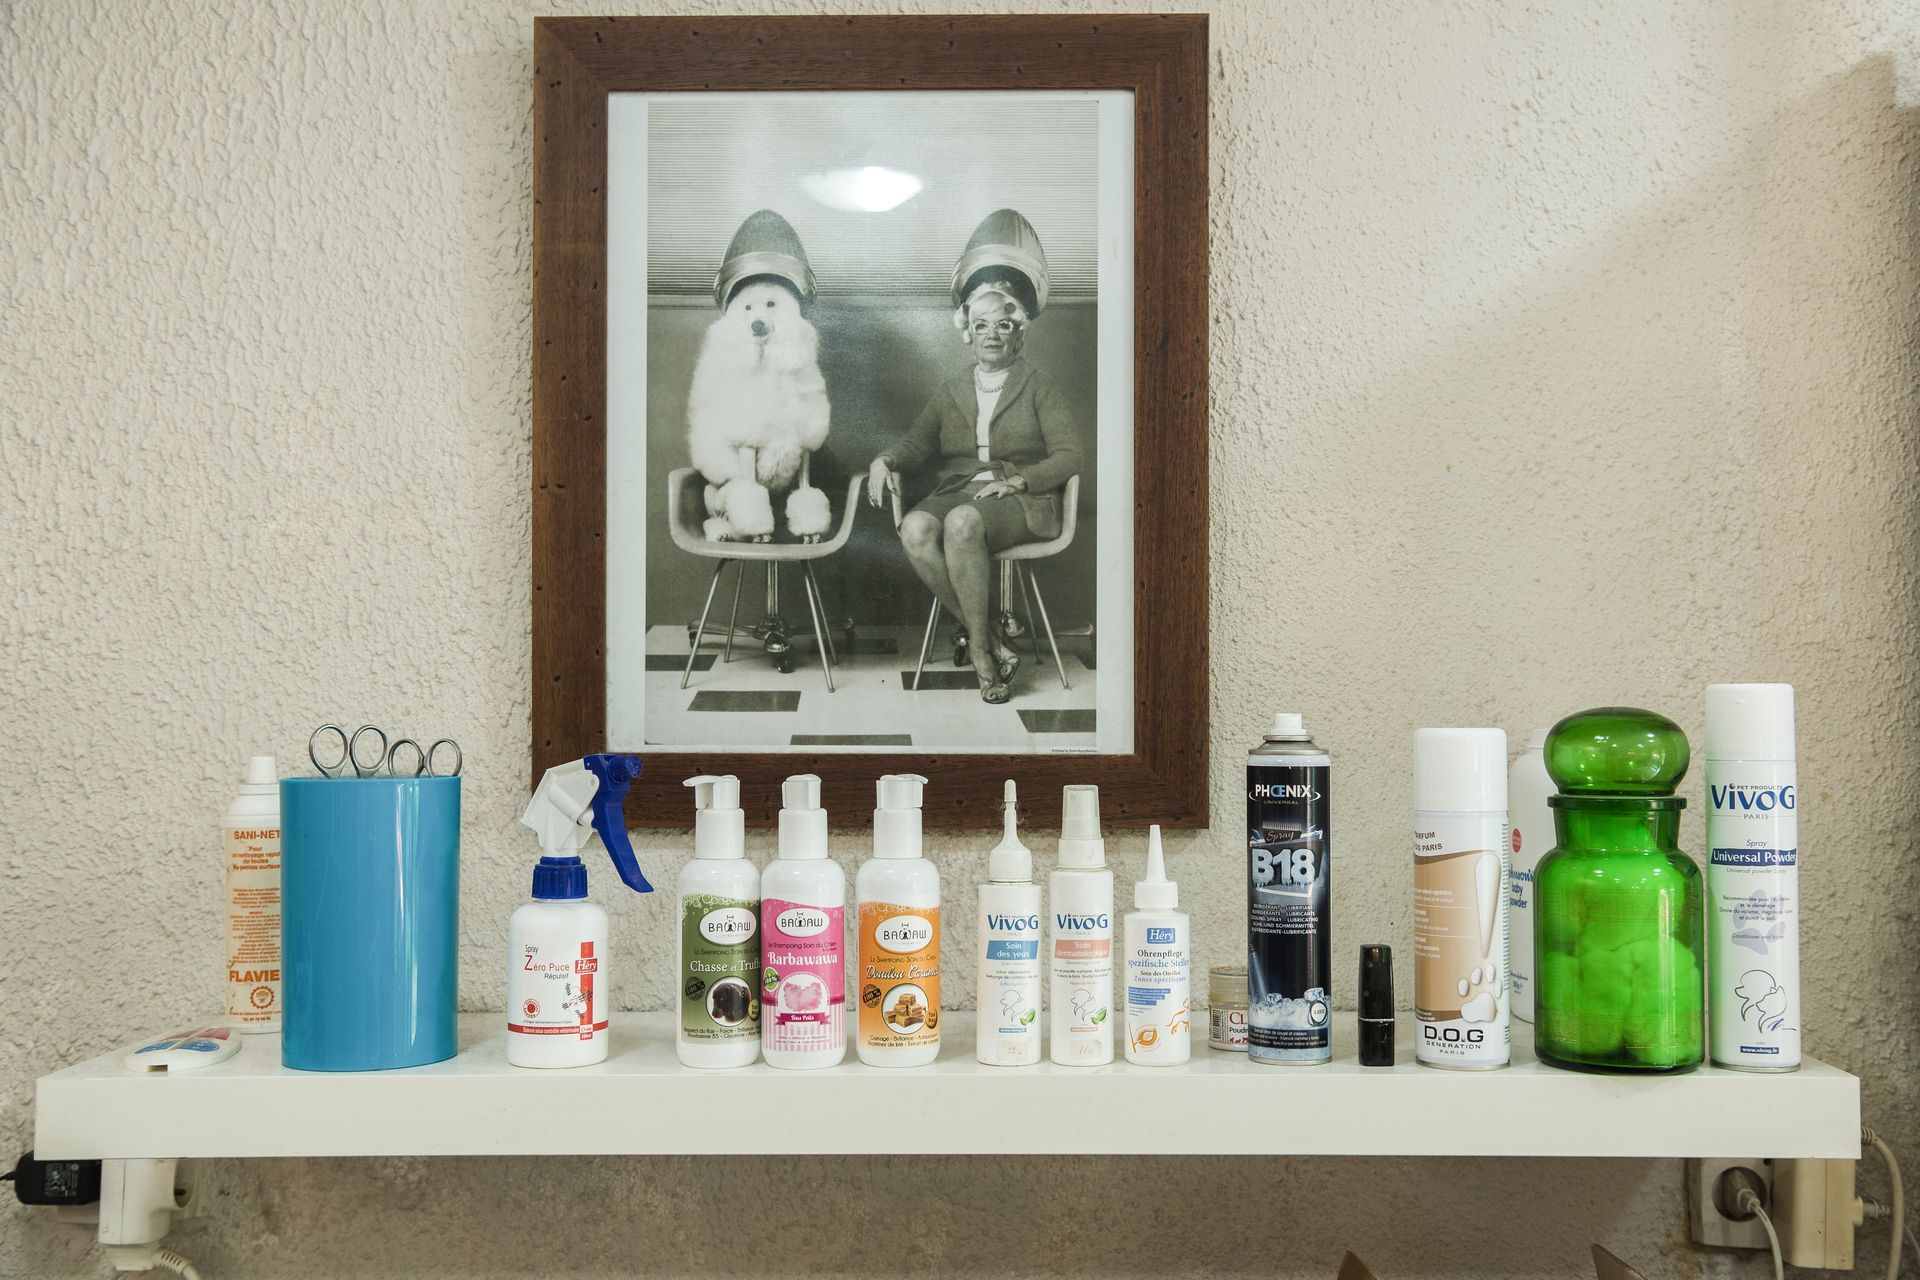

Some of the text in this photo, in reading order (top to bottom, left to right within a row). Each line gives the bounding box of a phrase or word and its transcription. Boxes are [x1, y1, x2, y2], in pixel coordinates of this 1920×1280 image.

[234, 830, 280, 839] SANI-NET
[1266, 831, 1295, 844] Spray
[1414, 831, 1435, 840] ARFUM
[1422, 843, 1443, 852] PARIS
[1746, 839, 1768, 848] Spray
[1713, 850, 1796, 863] Universal Powder
[1252, 848, 1316, 886] B18
[1150, 929, 1174, 942] Héry
[525, 944, 538, 954] Spray
[996, 950, 1010, 958] des
[1056, 949, 1108, 958] dermatologique
[1138, 950, 1182, 959] Ohrenpflege
[524, 954, 570, 972] Zéro Puce
[768, 952, 838, 965] Barbawawa
[1128, 959, 1169, 968] spezifische
[577, 960, 596, 972] Héry
[690, 960, 728, 972] Chasse
[230, 970, 280, 982] FLAVIE
[1229, 1011, 1248, 1024] CL
[1425, 1025, 1484, 1042] D.O.G
[1427, 1041, 1481, 1049] GENERATION
